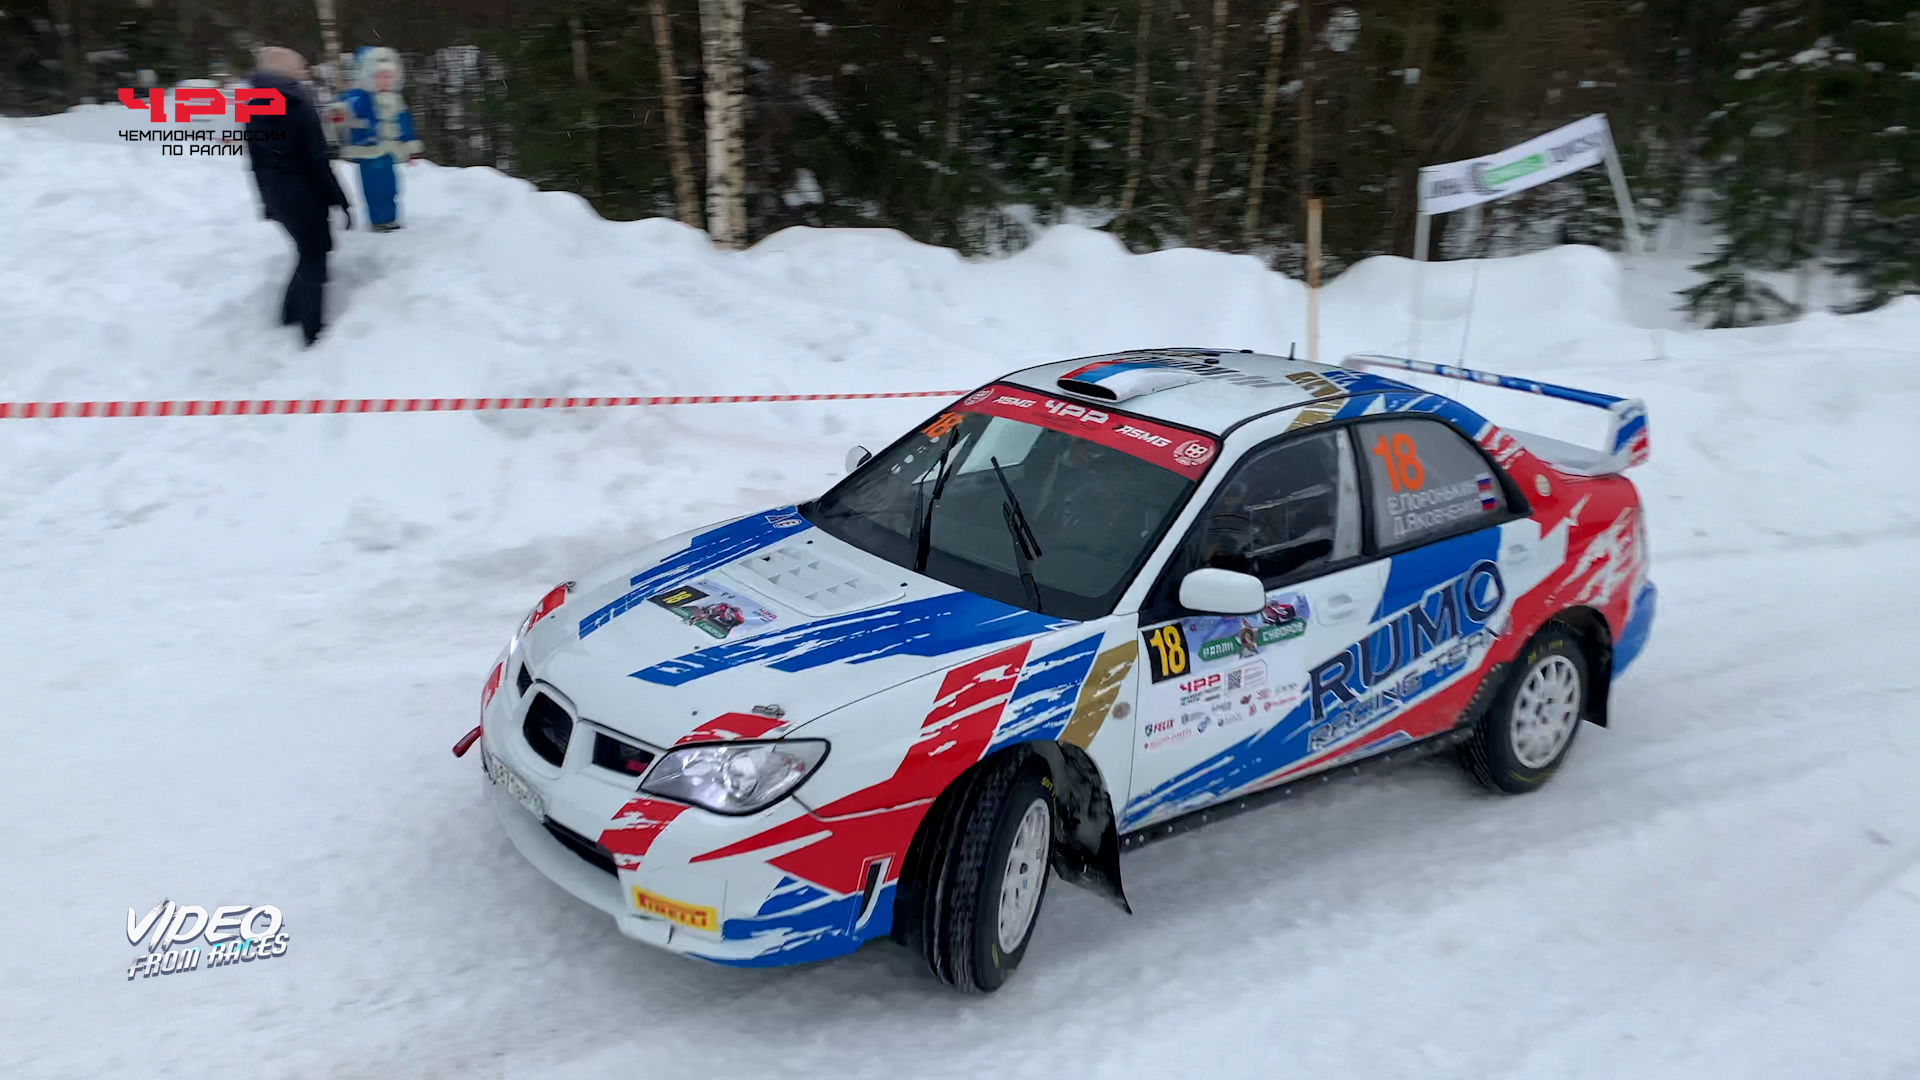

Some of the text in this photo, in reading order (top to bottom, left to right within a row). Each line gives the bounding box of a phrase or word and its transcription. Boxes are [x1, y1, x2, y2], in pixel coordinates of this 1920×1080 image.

[1045, 399, 1109, 424] ЧРР
[1372, 433, 1424, 493] 18
[1150, 625, 1186, 677] 18
[1308, 559, 1505, 722] RUMO
[1179, 673, 1221, 693] ЧРР
[638, 893, 708, 928] PIRELLI
